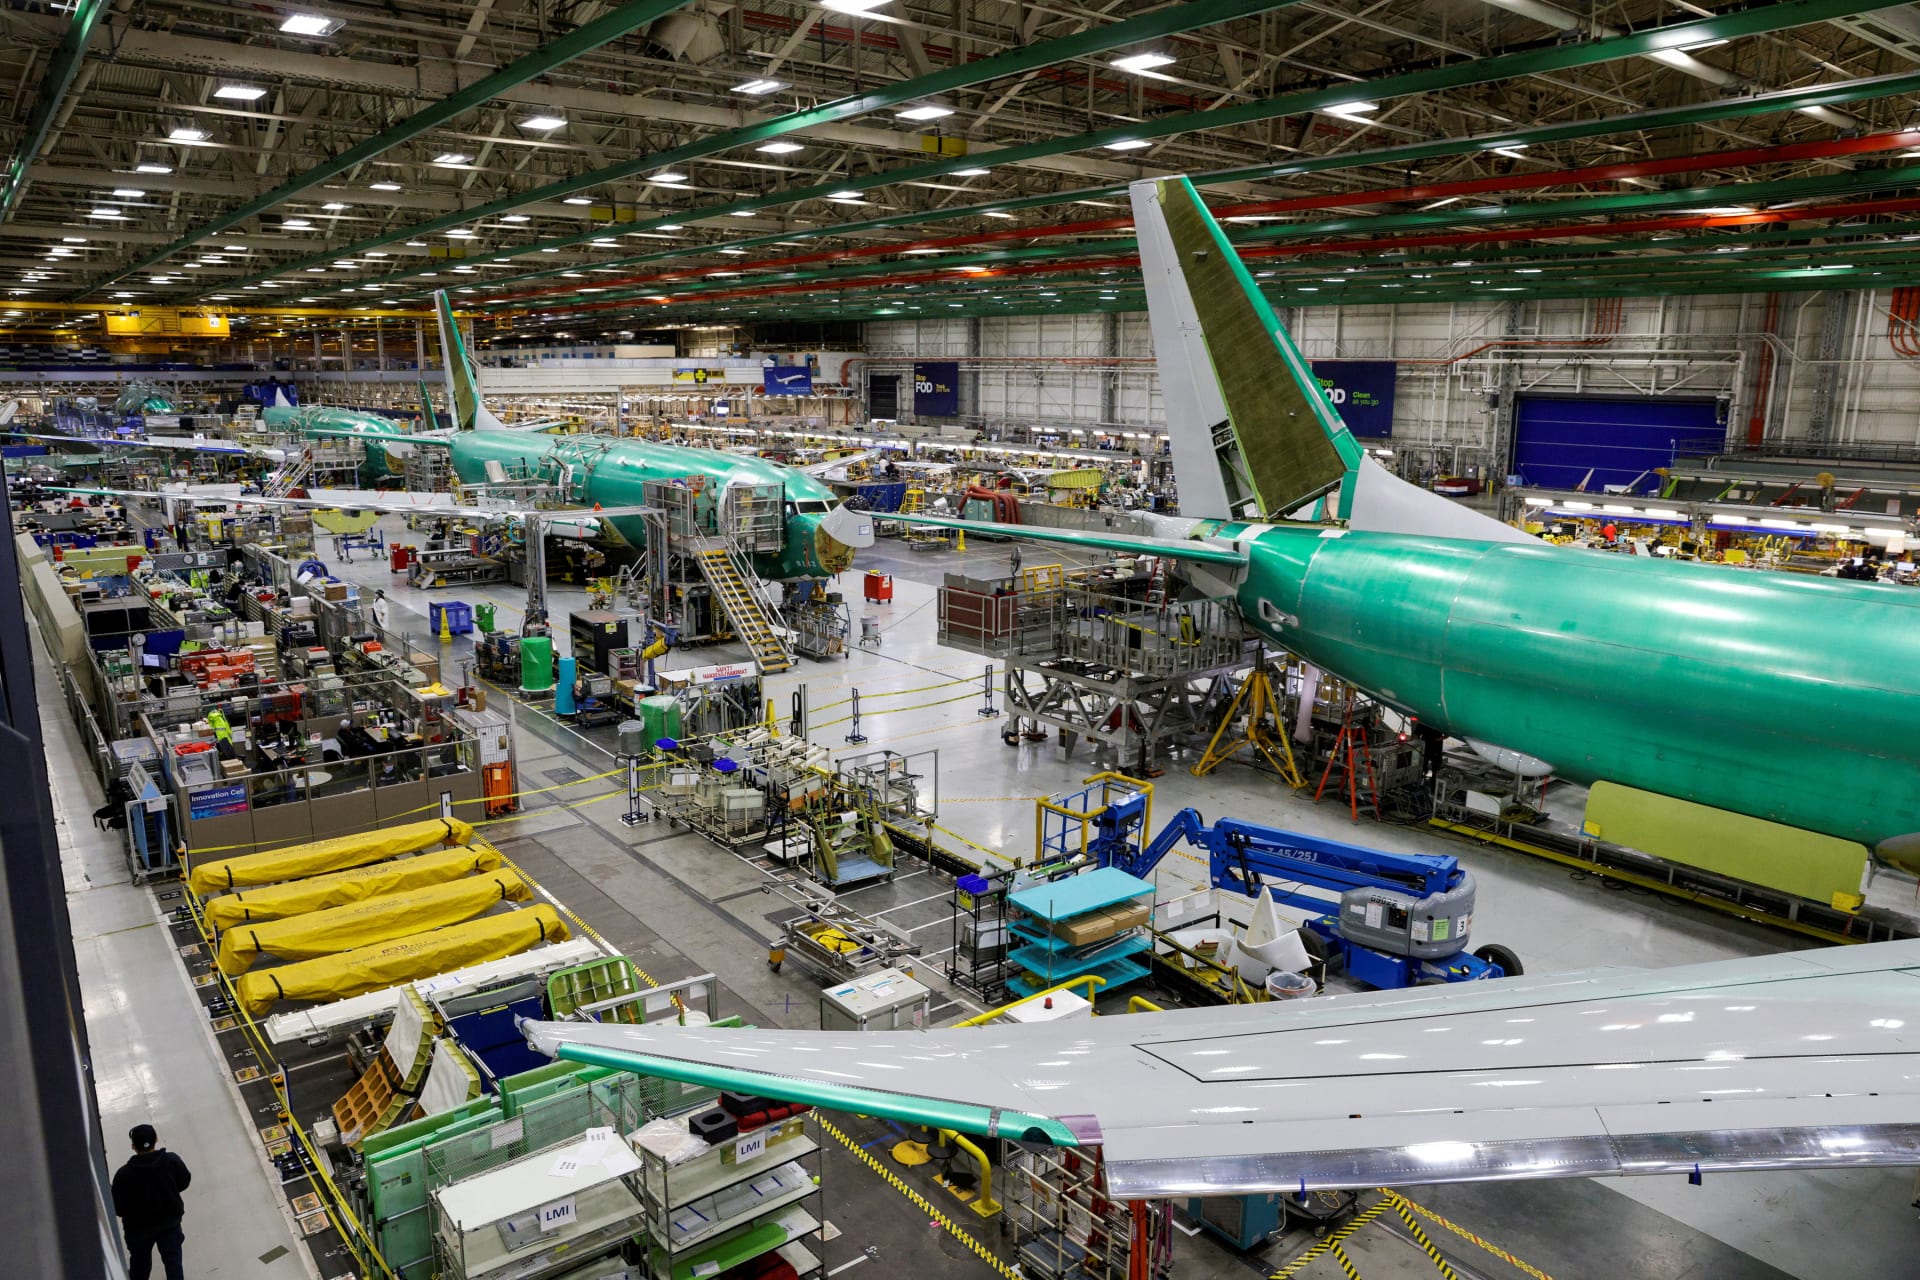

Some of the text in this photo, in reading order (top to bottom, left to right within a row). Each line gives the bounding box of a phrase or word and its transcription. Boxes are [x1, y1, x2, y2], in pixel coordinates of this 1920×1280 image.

[915, 381, 933, 393] FOD
[1324, 388, 1346, 404] OD
[1352, 391, 1371, 399] Clean
[1360, 399, 1370, 407] you
[191, 787, 245, 802] Innovation Cell
[1458, 920, 1466, 932] 3
[741, 1139, 760, 1155] LMI
[546, 1204, 569, 1221] LMI
